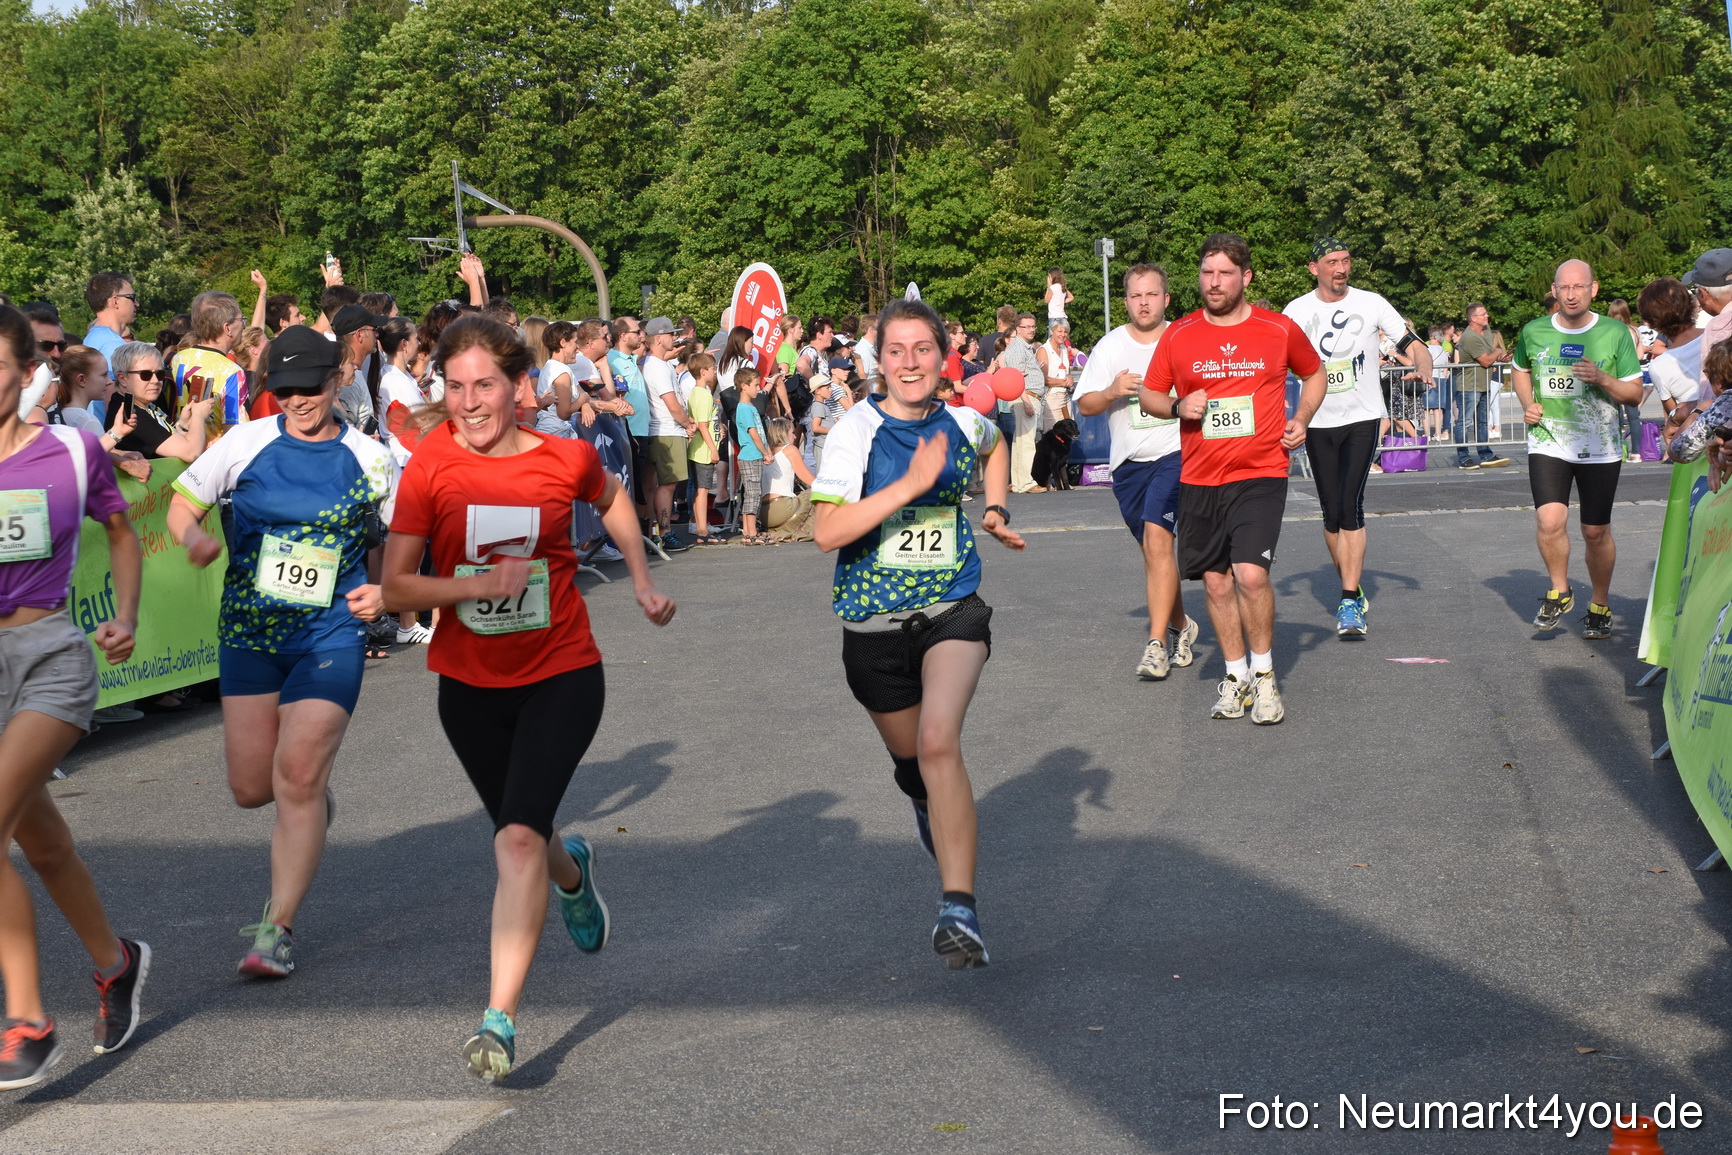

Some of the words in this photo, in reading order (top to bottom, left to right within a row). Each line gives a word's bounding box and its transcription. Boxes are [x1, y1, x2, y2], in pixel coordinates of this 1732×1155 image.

[1192, 359, 1220, 373] Echtes
[1222, 358, 1265, 370] Handwerk
[1229, 370, 1255, 378] FRISCH
[1549, 377, 1574, 390] 682
[1212, 411, 1242, 428] 588
[898, 529, 942, 552] 212
[275, 561, 319, 588] 199
[470, 615, 515, 623] Ochsenkühn
[517, 611, 537, 619] Sarah
[98, 638, 220, 691] www.firmenlauf-oberpfalz.
